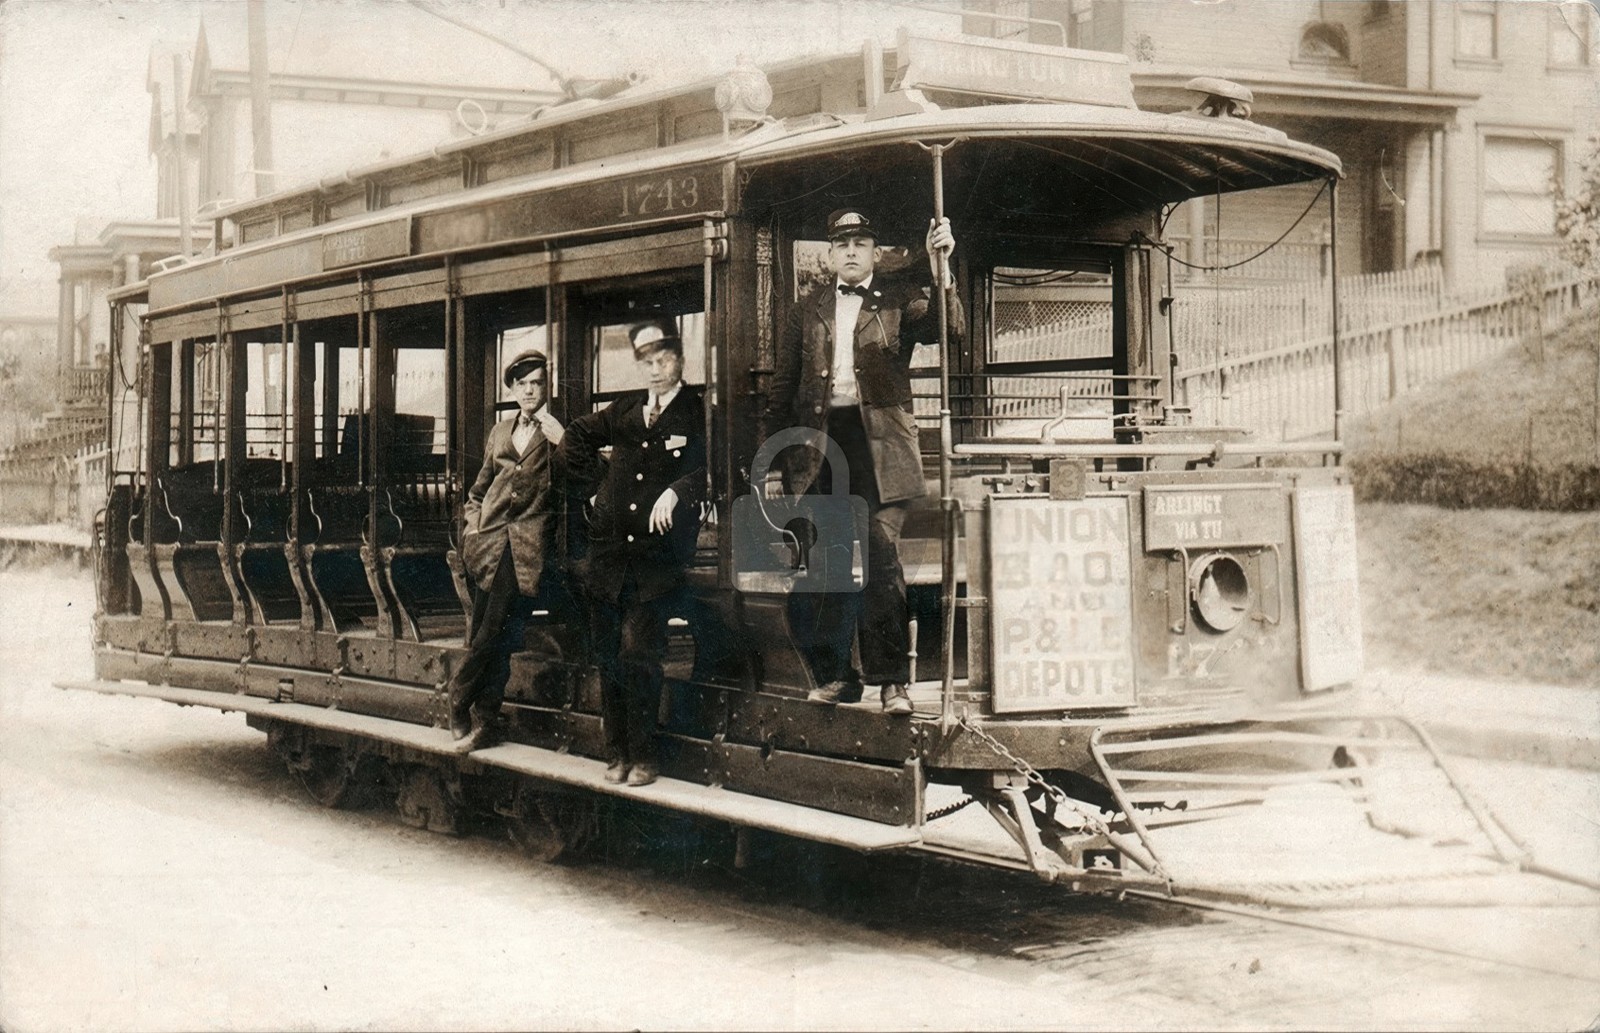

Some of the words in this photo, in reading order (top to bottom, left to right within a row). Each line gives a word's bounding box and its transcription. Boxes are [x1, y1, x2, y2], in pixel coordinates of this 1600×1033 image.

[619, 176, 699, 217] 1743
[1154, 495, 1222, 515] ARLINGT
[997, 507, 1126, 544] UNION
[1175, 521, 1198, 539] VIA
[1201, 520, 1222, 539] TU
[1004, 659, 1131, 698] DEPOTS
